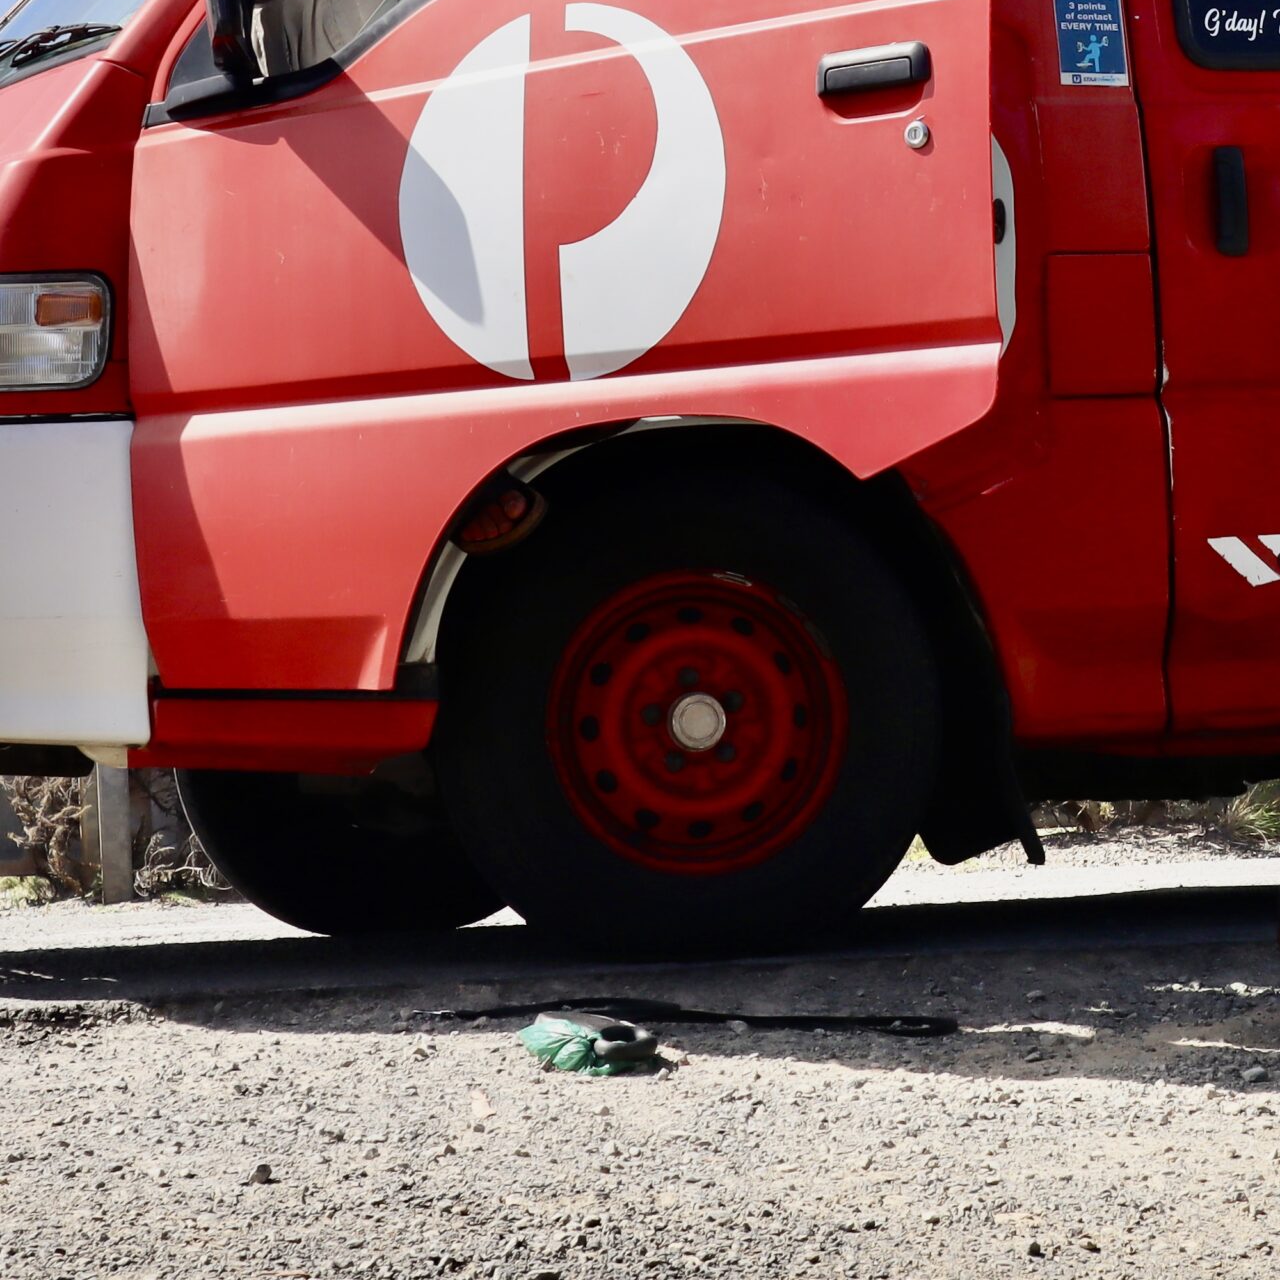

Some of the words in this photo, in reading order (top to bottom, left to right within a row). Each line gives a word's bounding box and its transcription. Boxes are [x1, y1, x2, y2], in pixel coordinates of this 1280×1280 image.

[1068, 1, 1075, 10] 3
[1077, 2, 1106, 11] points
[1065, 11, 1075, 20] of
[1077, 12, 1112, 21] contact
[1060, 22, 1092, 31] EVERY
[1094, 23, 1119, 31] TIME
[1204, 8, 1266, 41] G'day!
